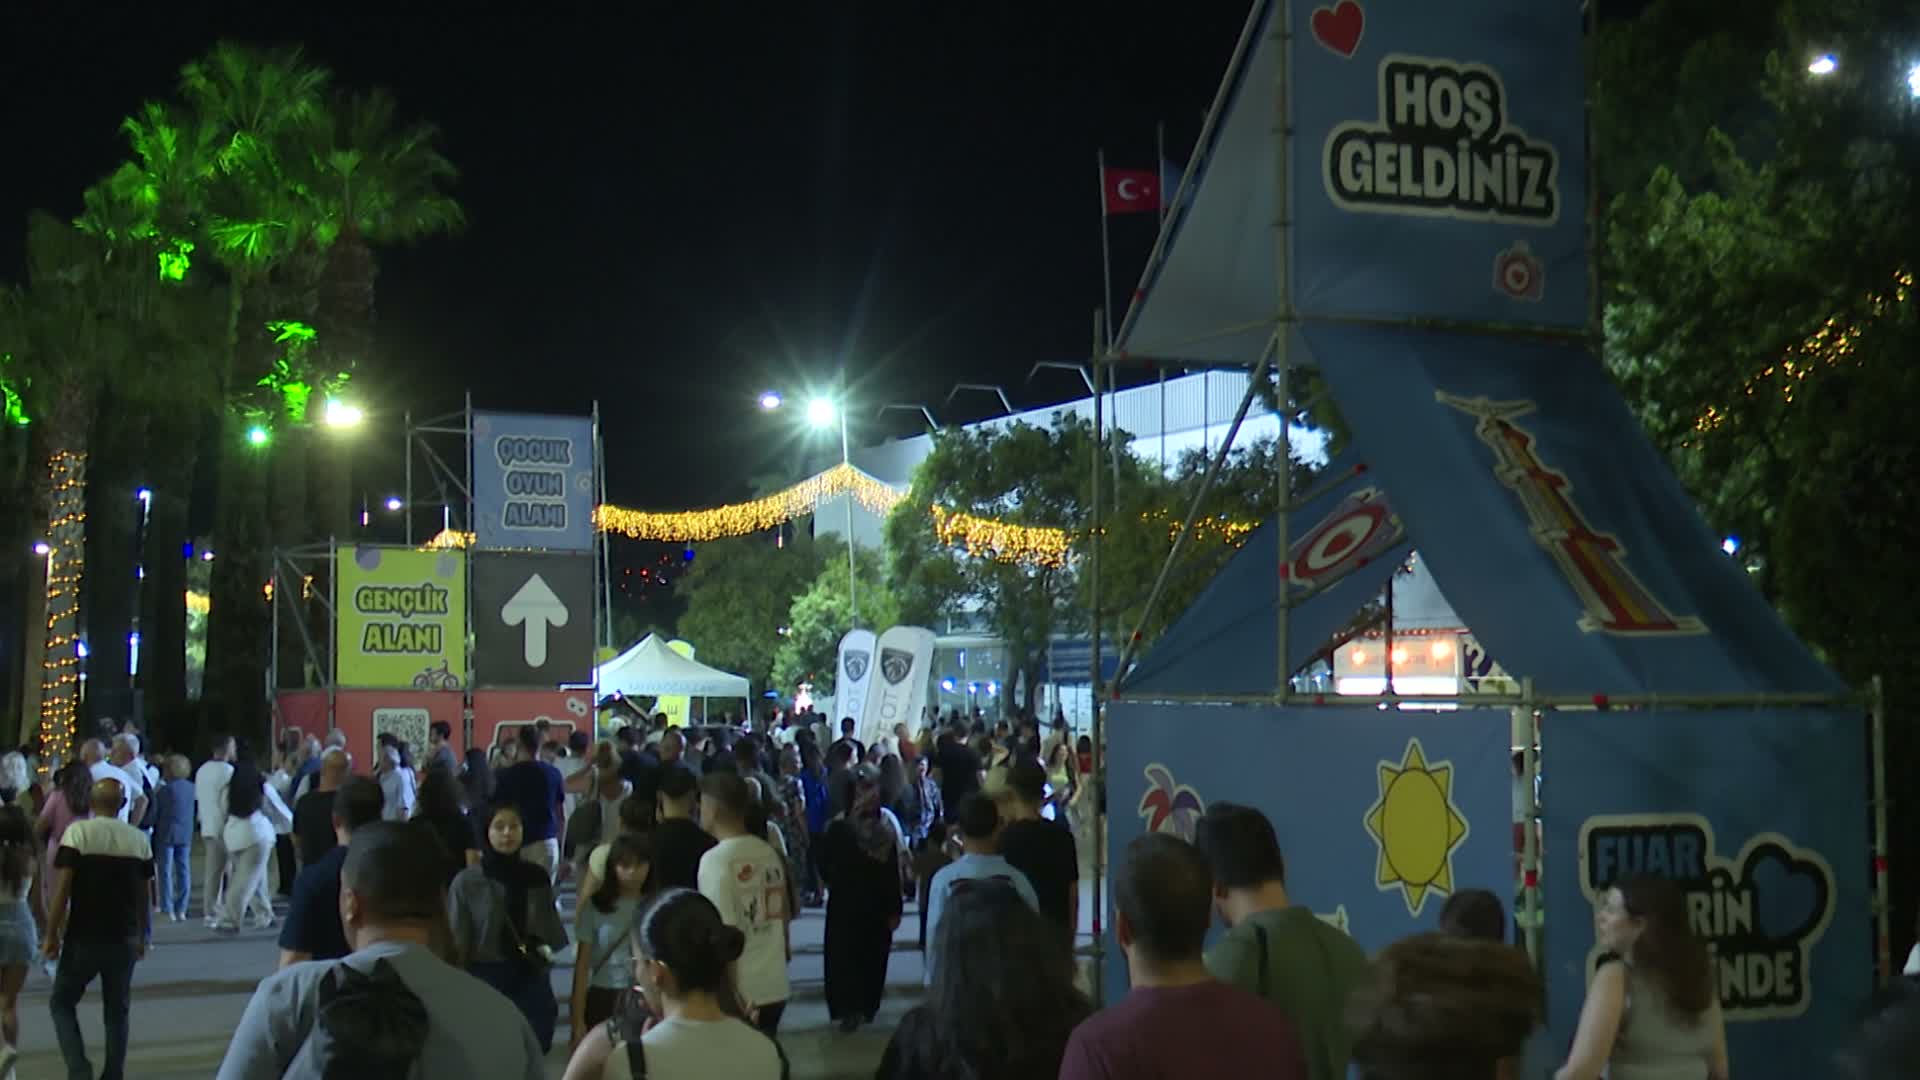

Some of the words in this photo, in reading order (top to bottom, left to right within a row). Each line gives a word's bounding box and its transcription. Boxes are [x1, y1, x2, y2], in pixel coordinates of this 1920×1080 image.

[1393, 71, 1493, 140] HOŞ
[1338, 137, 1547, 208] GELDİNİZ
[498, 437, 570, 465] ÇOCUK
[506, 471, 563, 496] OYUN
[504, 502, 566, 527] ALANI
[356, 584, 448, 616] GENÇLİK
[363, 623, 442, 653] ALANI
[1594, 832, 1700, 882] FUAR
